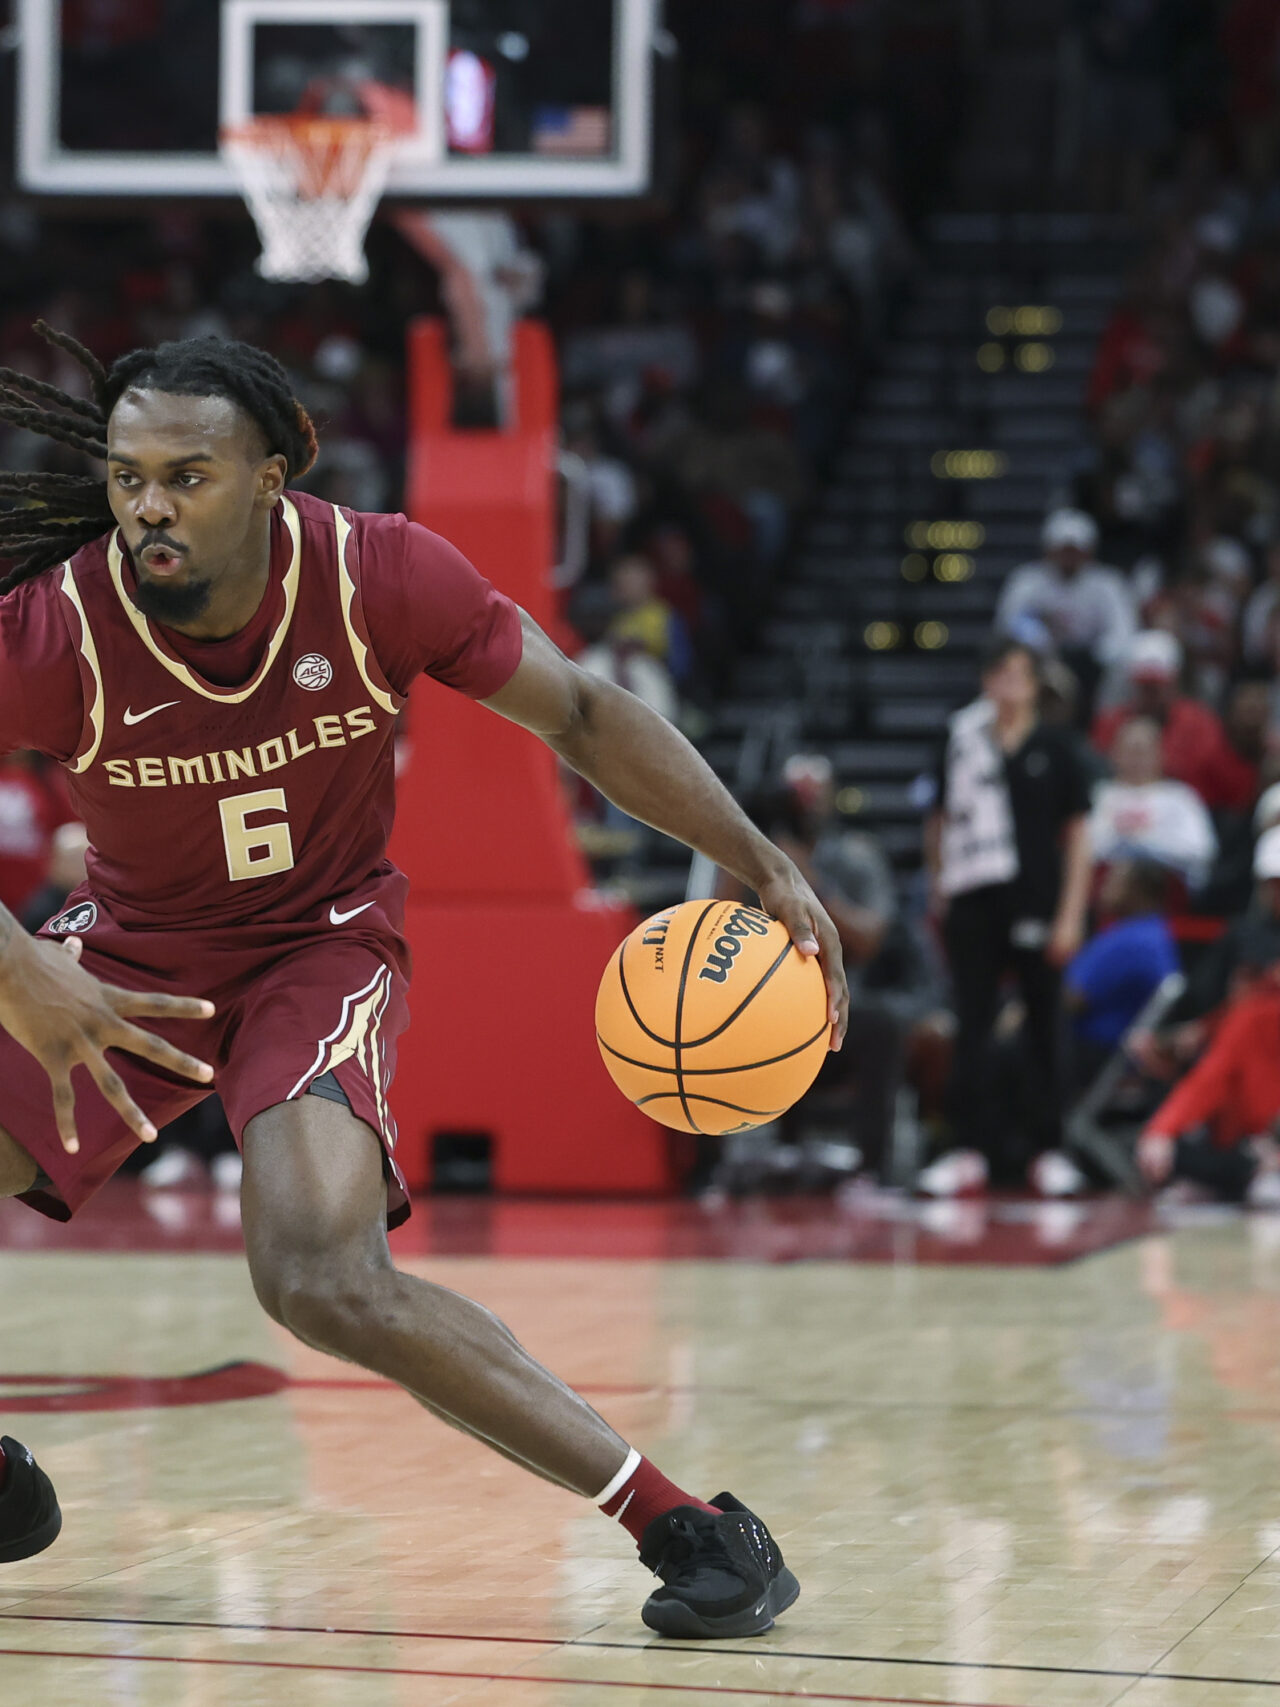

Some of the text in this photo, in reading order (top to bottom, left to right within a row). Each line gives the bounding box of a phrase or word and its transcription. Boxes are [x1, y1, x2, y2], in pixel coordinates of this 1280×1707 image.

[299, 662, 327, 678] ACC
[102, 706, 377, 787] SEMINOLES
[218, 787, 294, 882] 6
[655, 947, 665, 973] NXT
